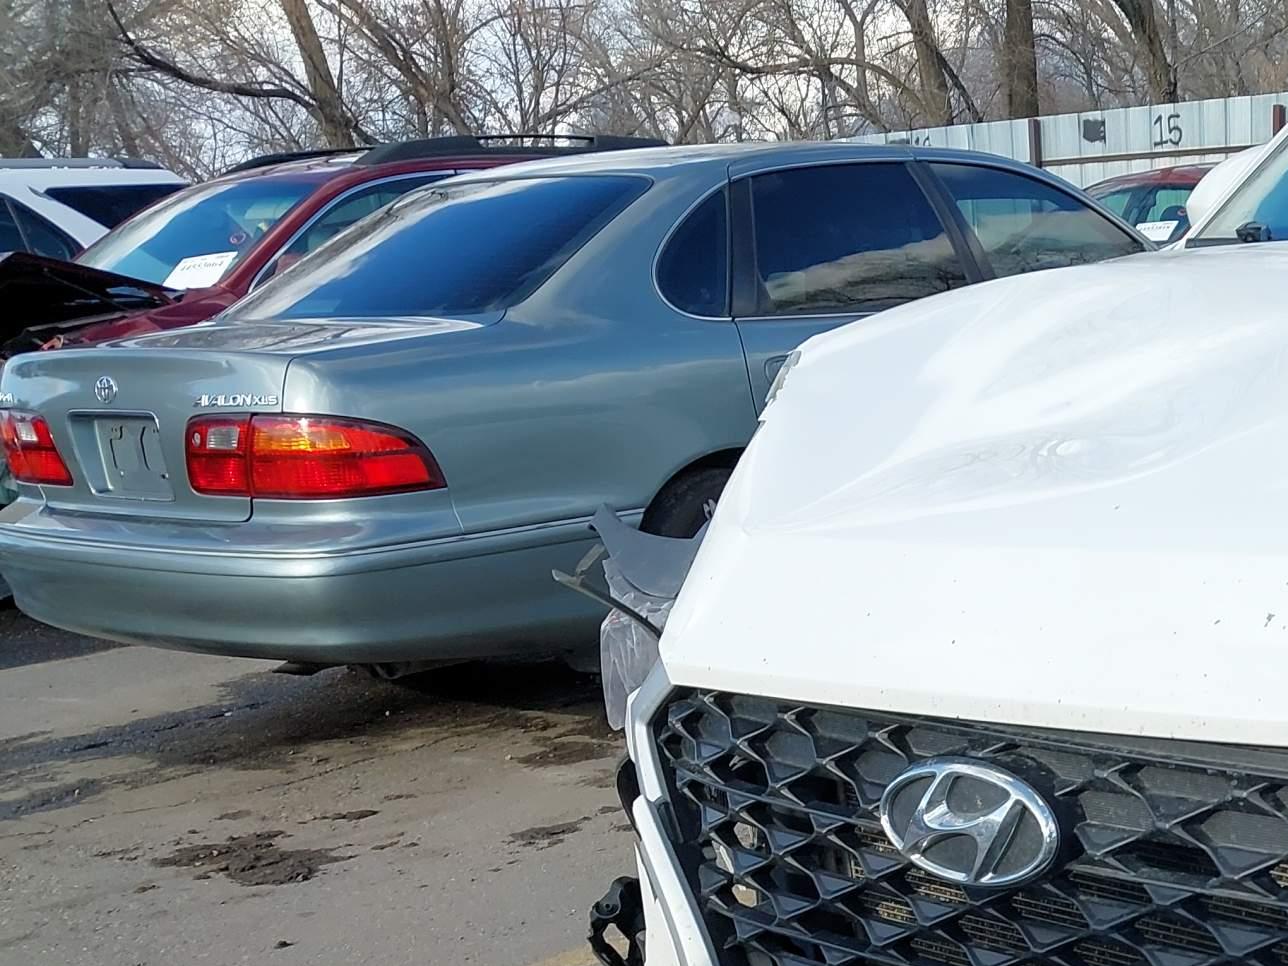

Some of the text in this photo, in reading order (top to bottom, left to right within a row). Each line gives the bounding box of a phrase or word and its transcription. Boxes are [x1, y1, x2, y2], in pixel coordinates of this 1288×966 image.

[1152, 112, 1183, 148] 15
[194, 393, 279, 407] AVALON XLS
